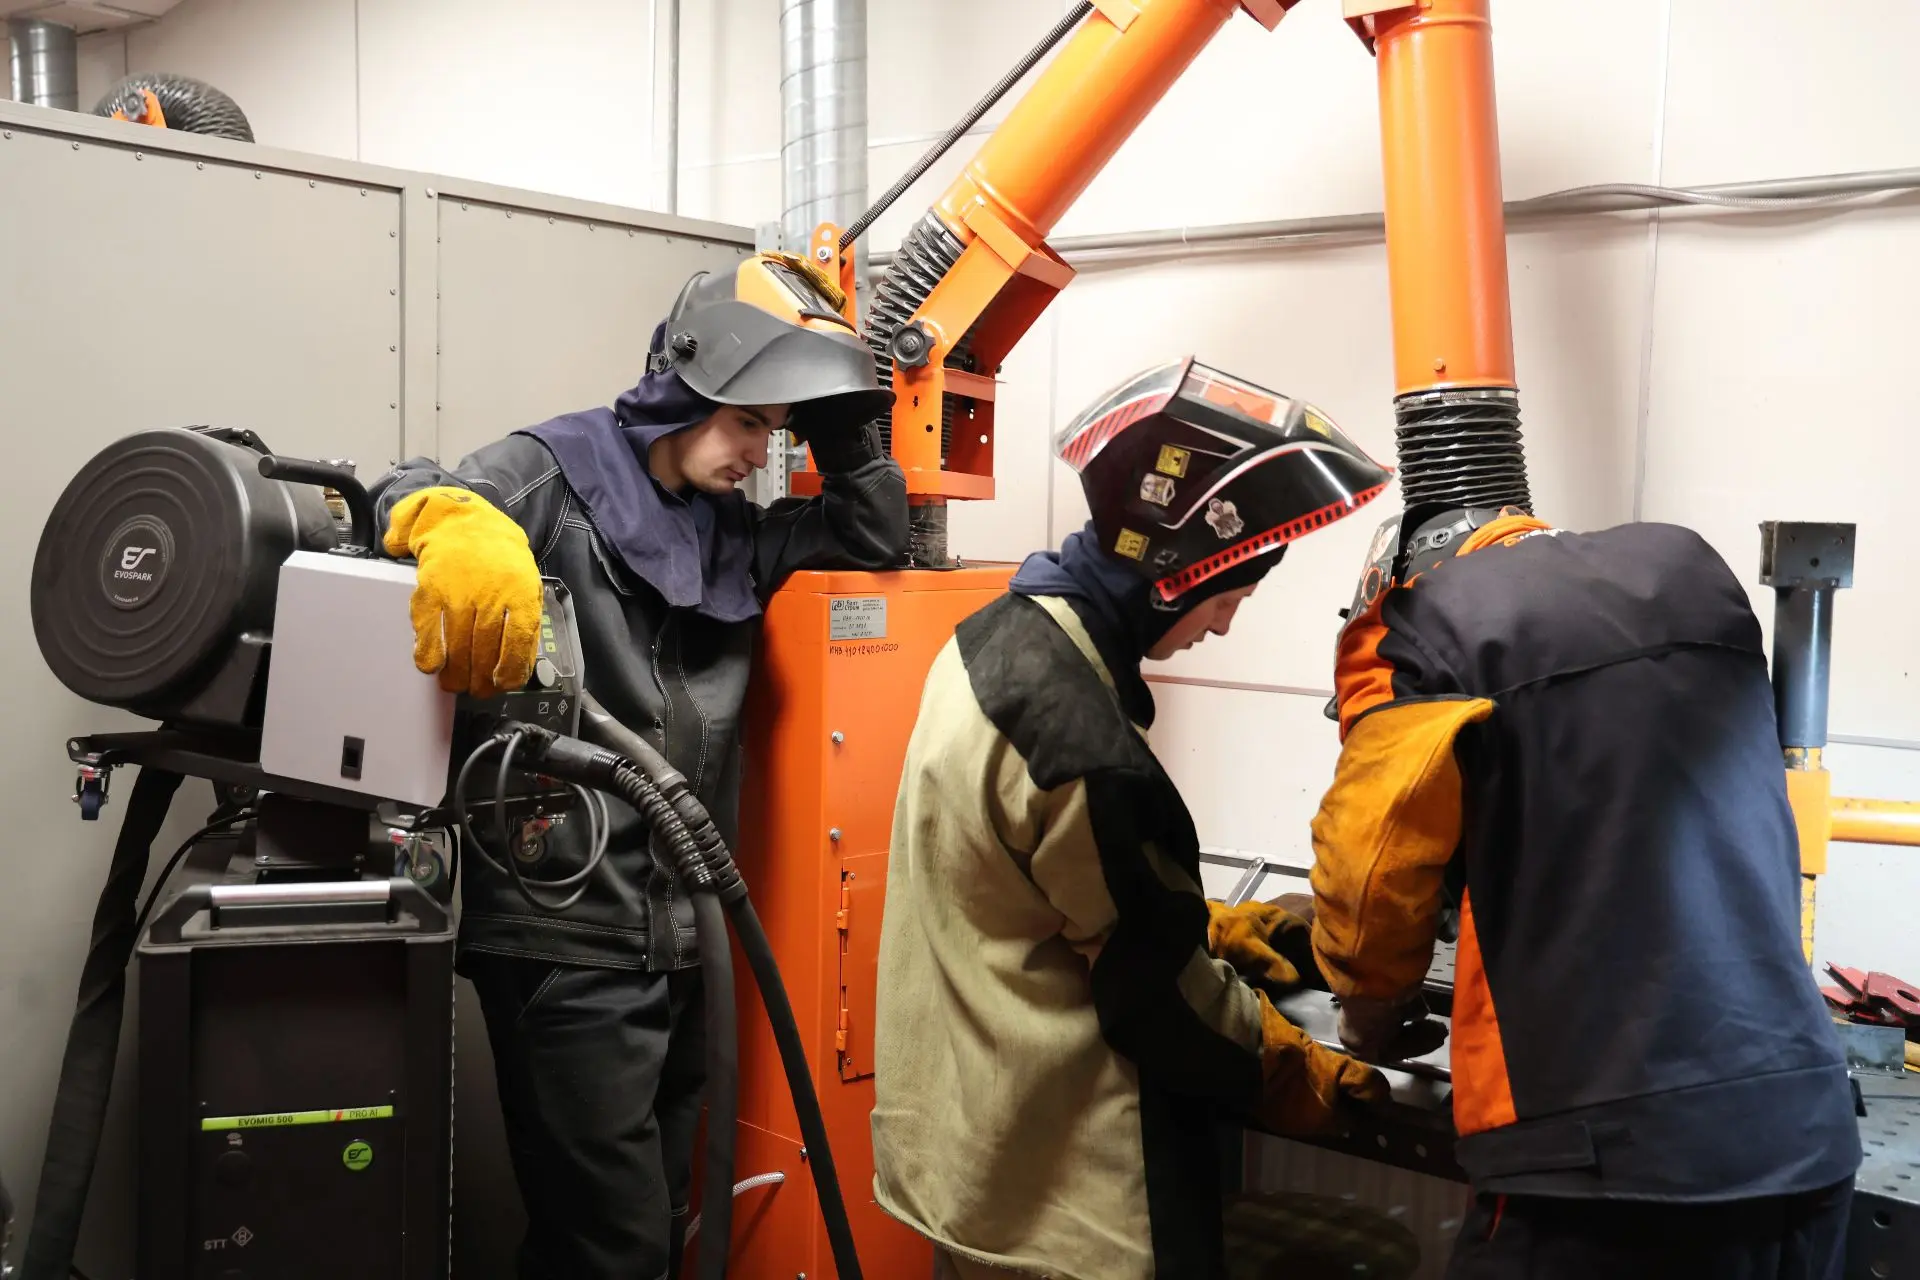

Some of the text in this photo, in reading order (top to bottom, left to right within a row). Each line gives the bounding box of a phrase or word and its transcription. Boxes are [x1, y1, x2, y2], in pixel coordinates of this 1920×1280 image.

[114, 570, 153, 581] EVOSPARK
[350, 1109, 367, 1118] PRO
[238, 1115, 294, 1127] EVOMIG 500
[204, 1239, 228, 1250] STT
